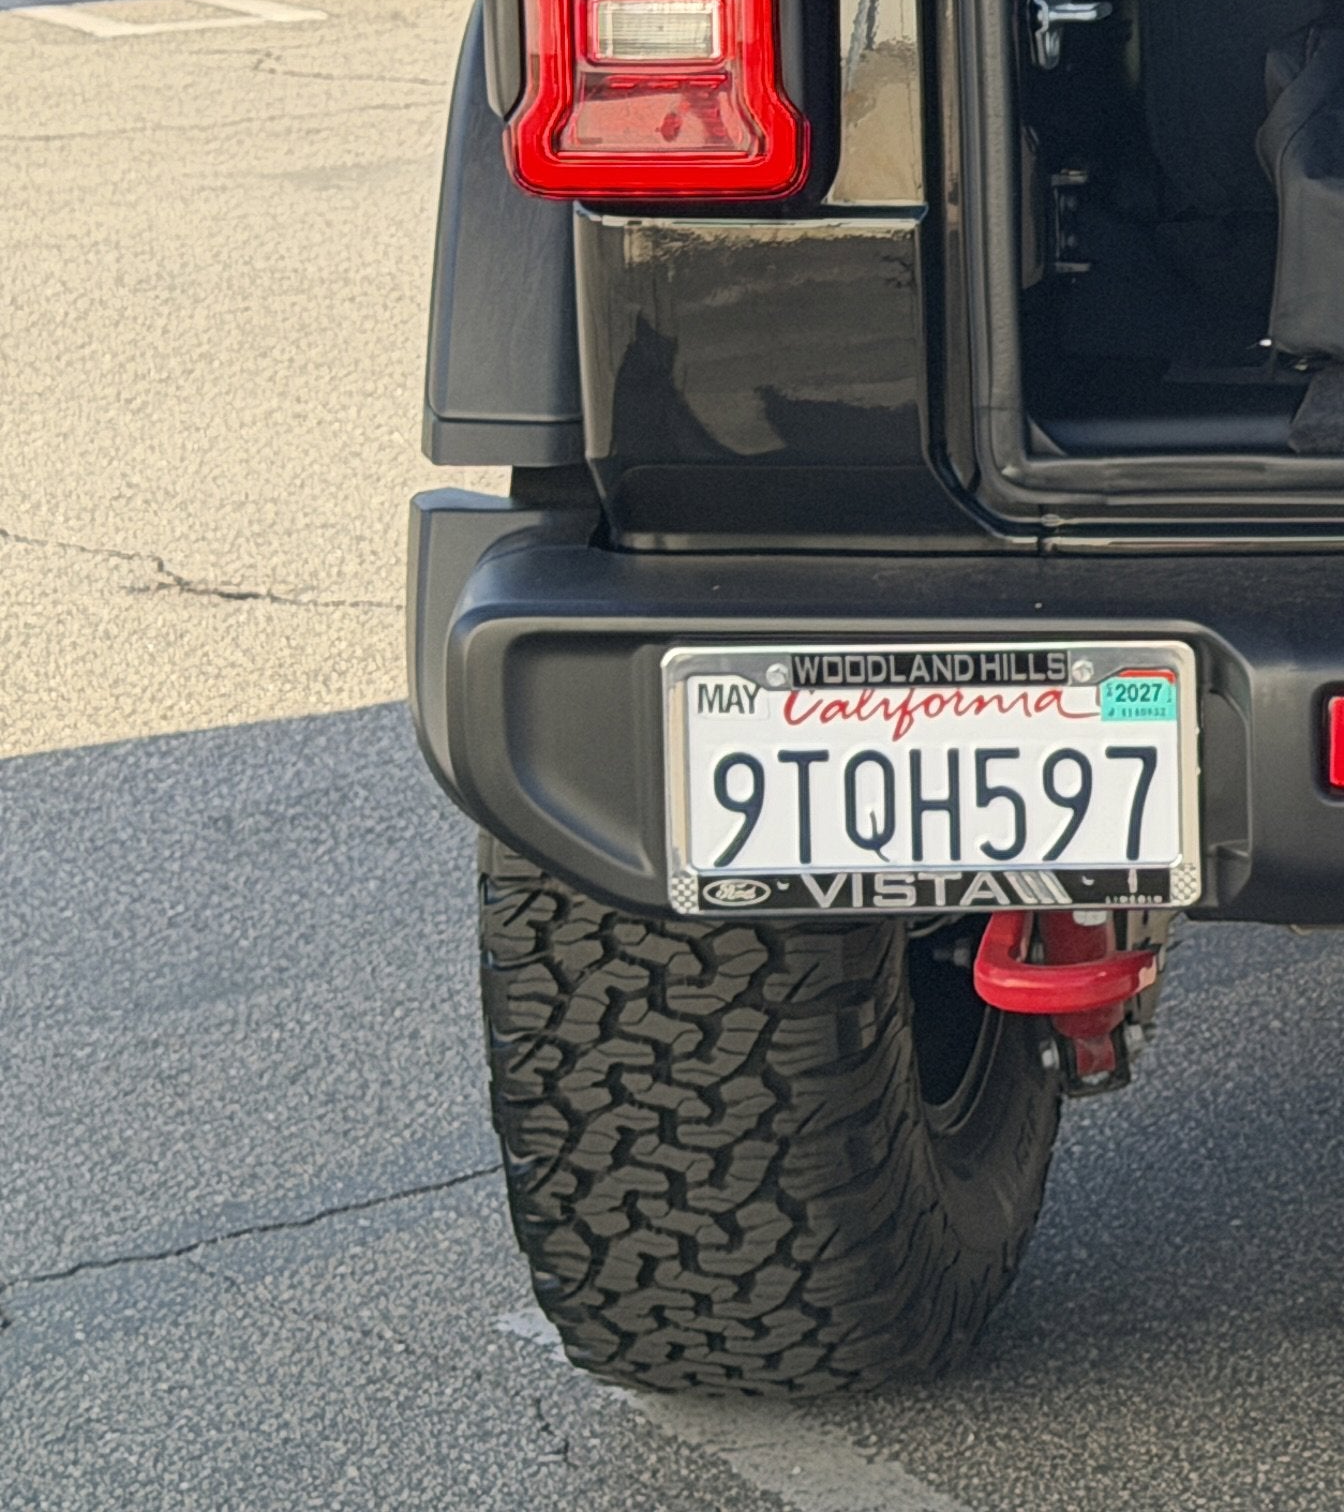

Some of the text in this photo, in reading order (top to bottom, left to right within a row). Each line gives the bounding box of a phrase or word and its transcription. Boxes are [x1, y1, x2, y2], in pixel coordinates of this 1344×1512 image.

[794, 652, 1067, 684] WOODLAND HILLS
[697, 683, 761, 715] MAY
[1115, 683, 1162, 702] 2027
[783, 686, 1100, 742] California
[713, 745, 1159, 868] 9TQH597
[800, 871, 1010, 908] VISTA
